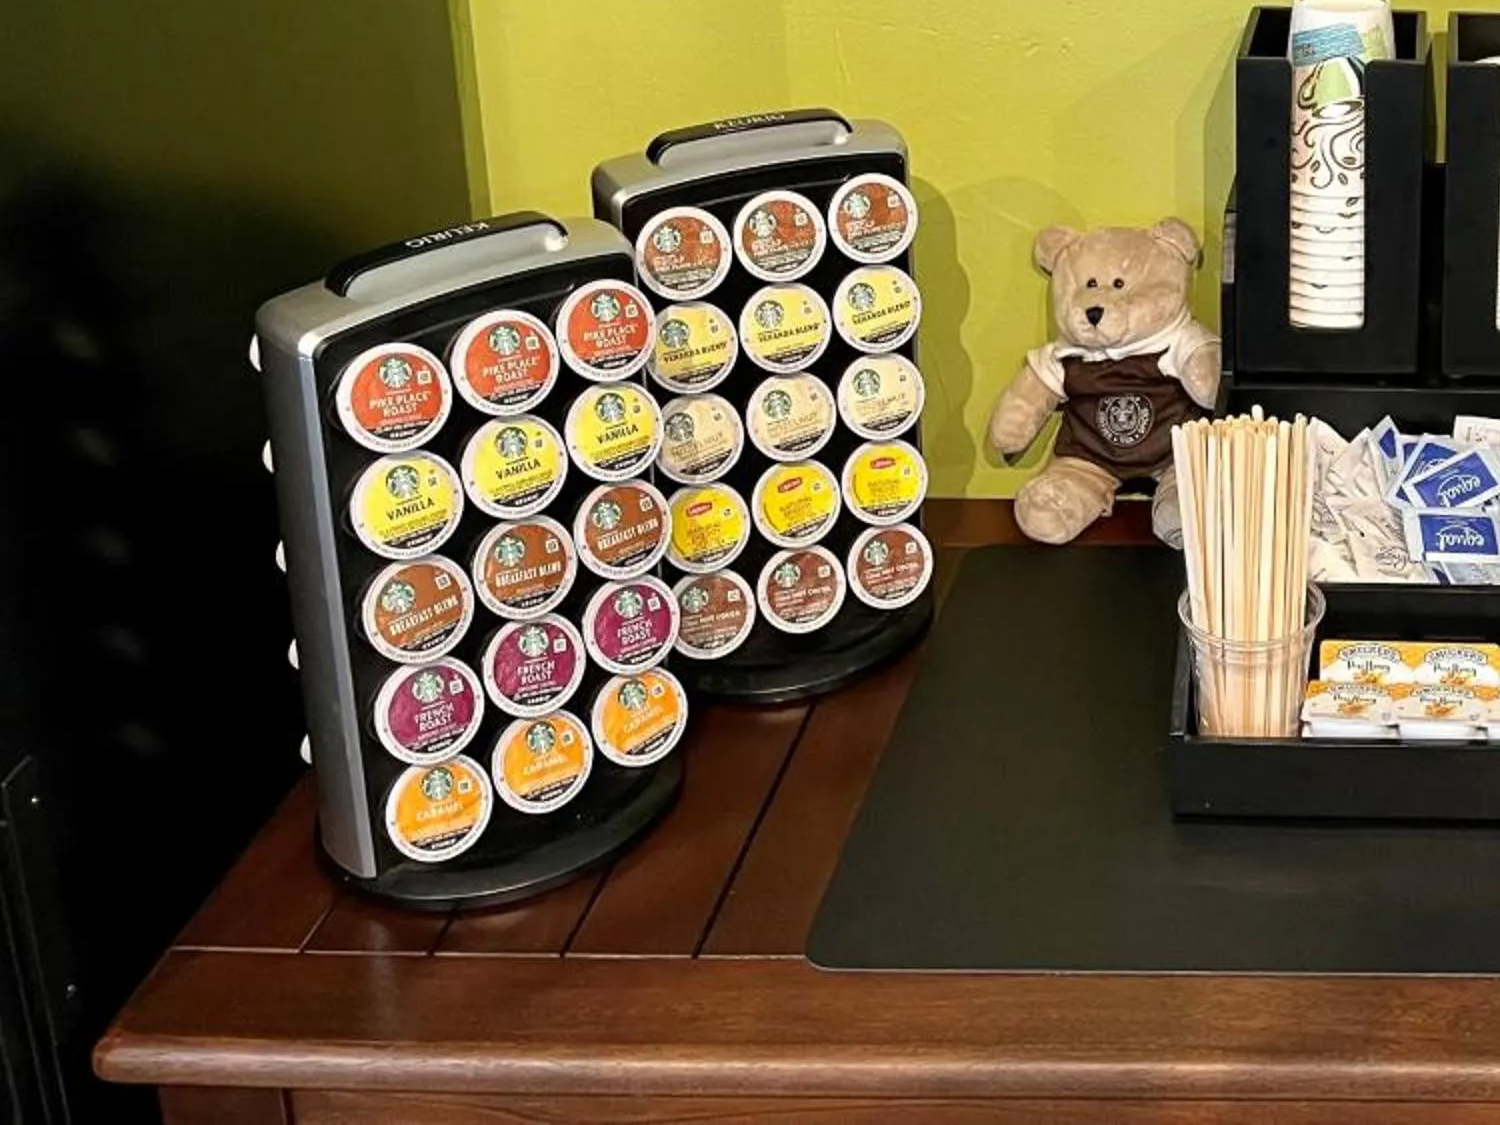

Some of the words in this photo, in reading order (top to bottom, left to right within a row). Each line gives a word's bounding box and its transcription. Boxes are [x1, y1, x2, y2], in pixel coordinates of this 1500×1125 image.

[596, 423, 639, 443] VANILLA
[496, 458, 541, 479] VANILLA
[386, 497, 435, 521] VANILLA
